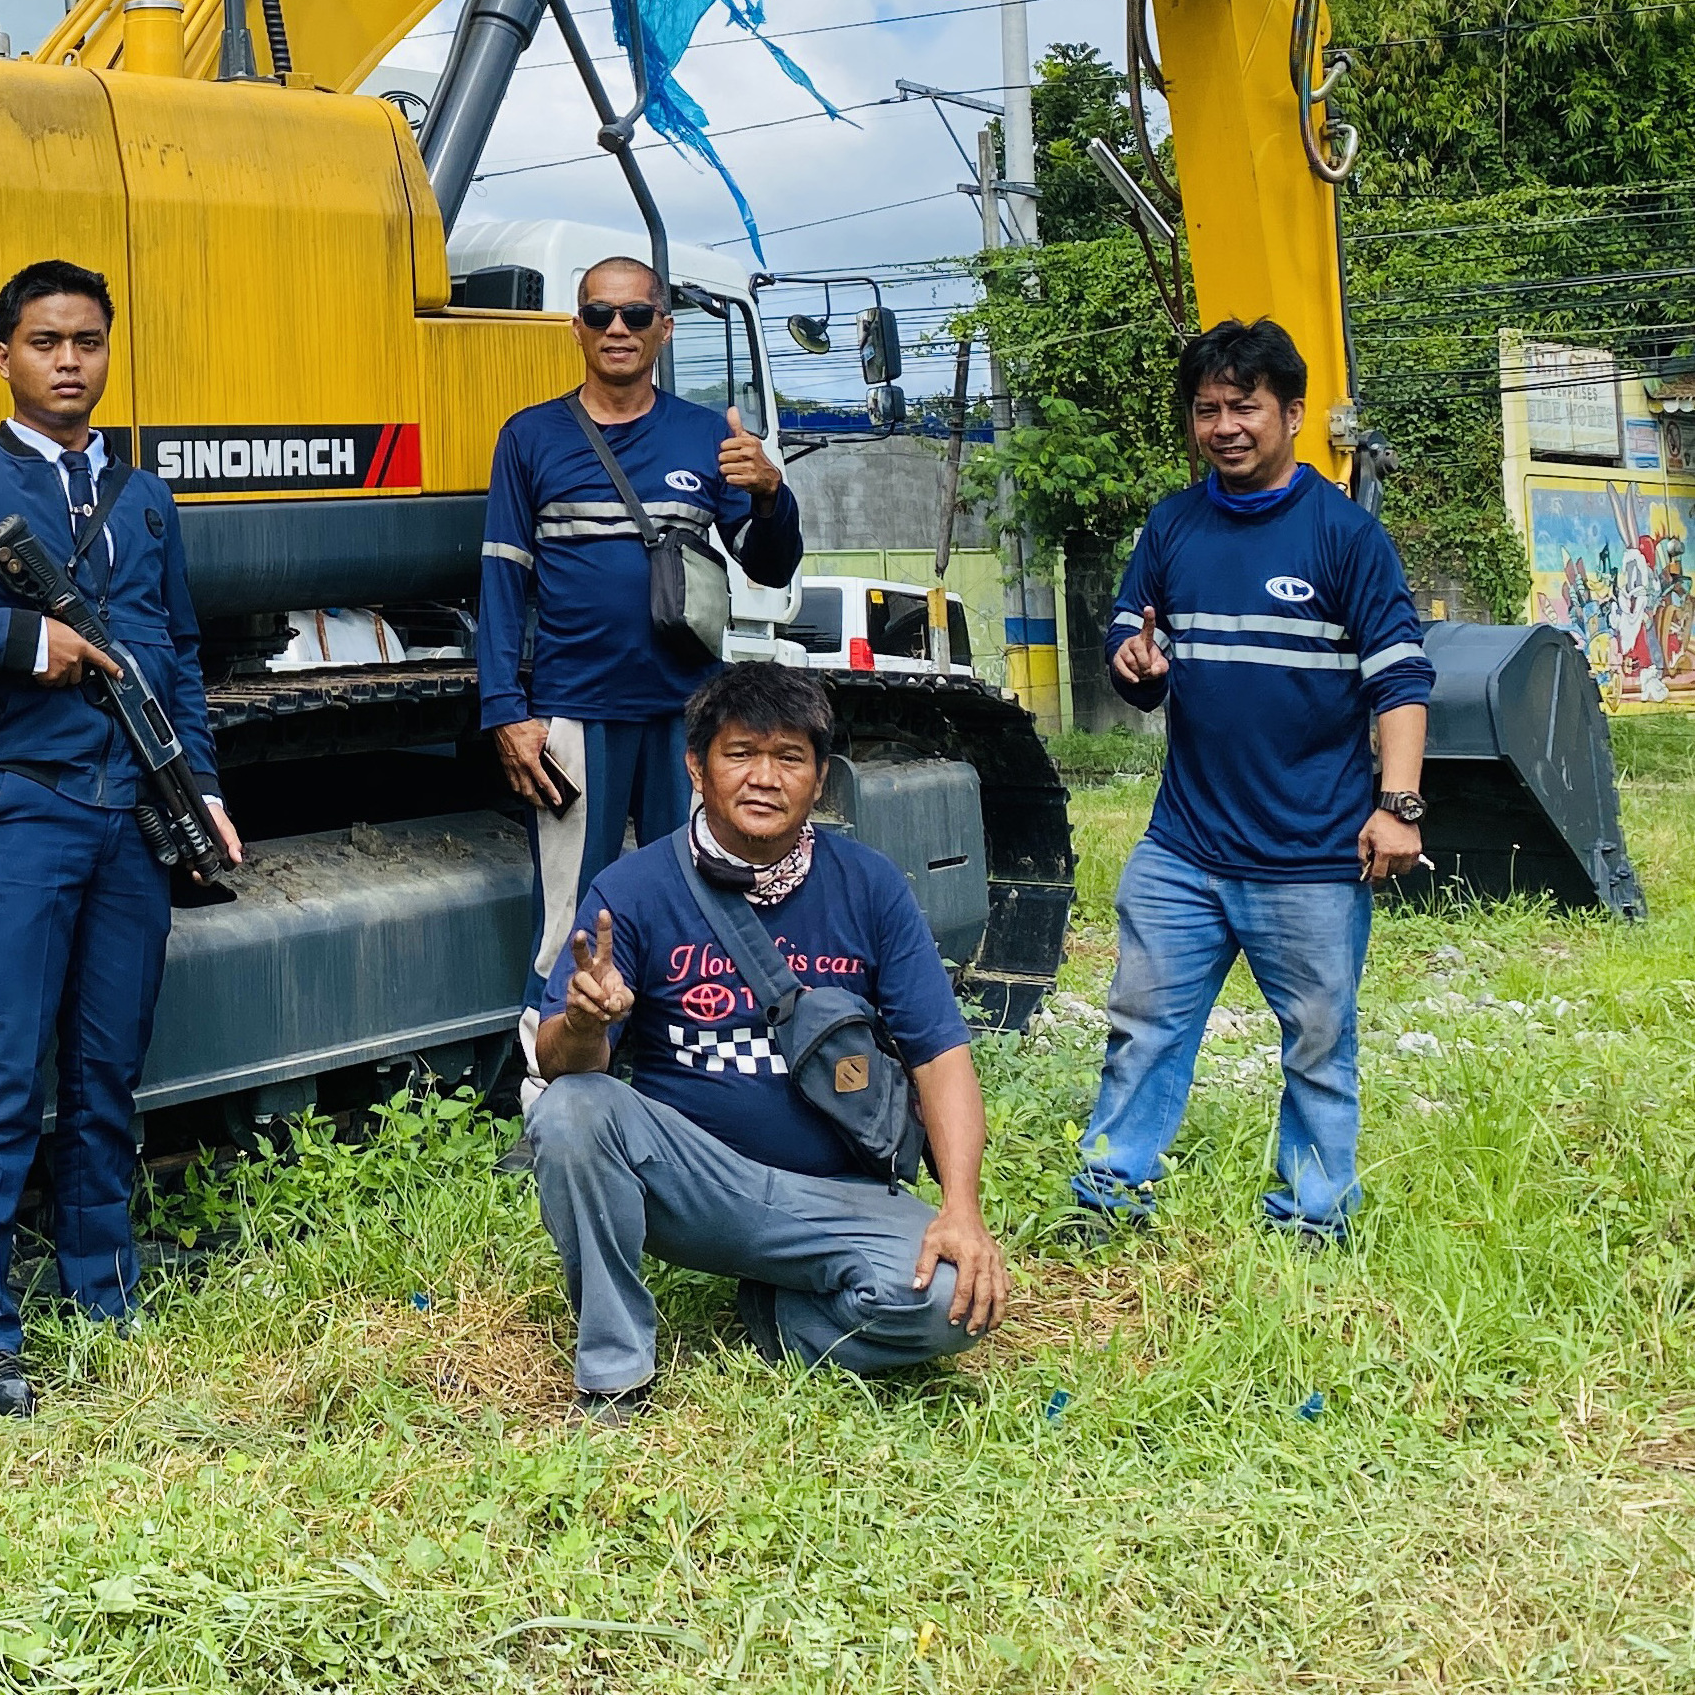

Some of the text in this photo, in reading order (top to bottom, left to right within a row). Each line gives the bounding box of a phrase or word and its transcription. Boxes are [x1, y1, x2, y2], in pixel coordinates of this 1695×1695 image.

[157, 438, 355, 479] SINOMACH
[666, 944, 696, 982] I
[699, 942, 736, 978] lo
